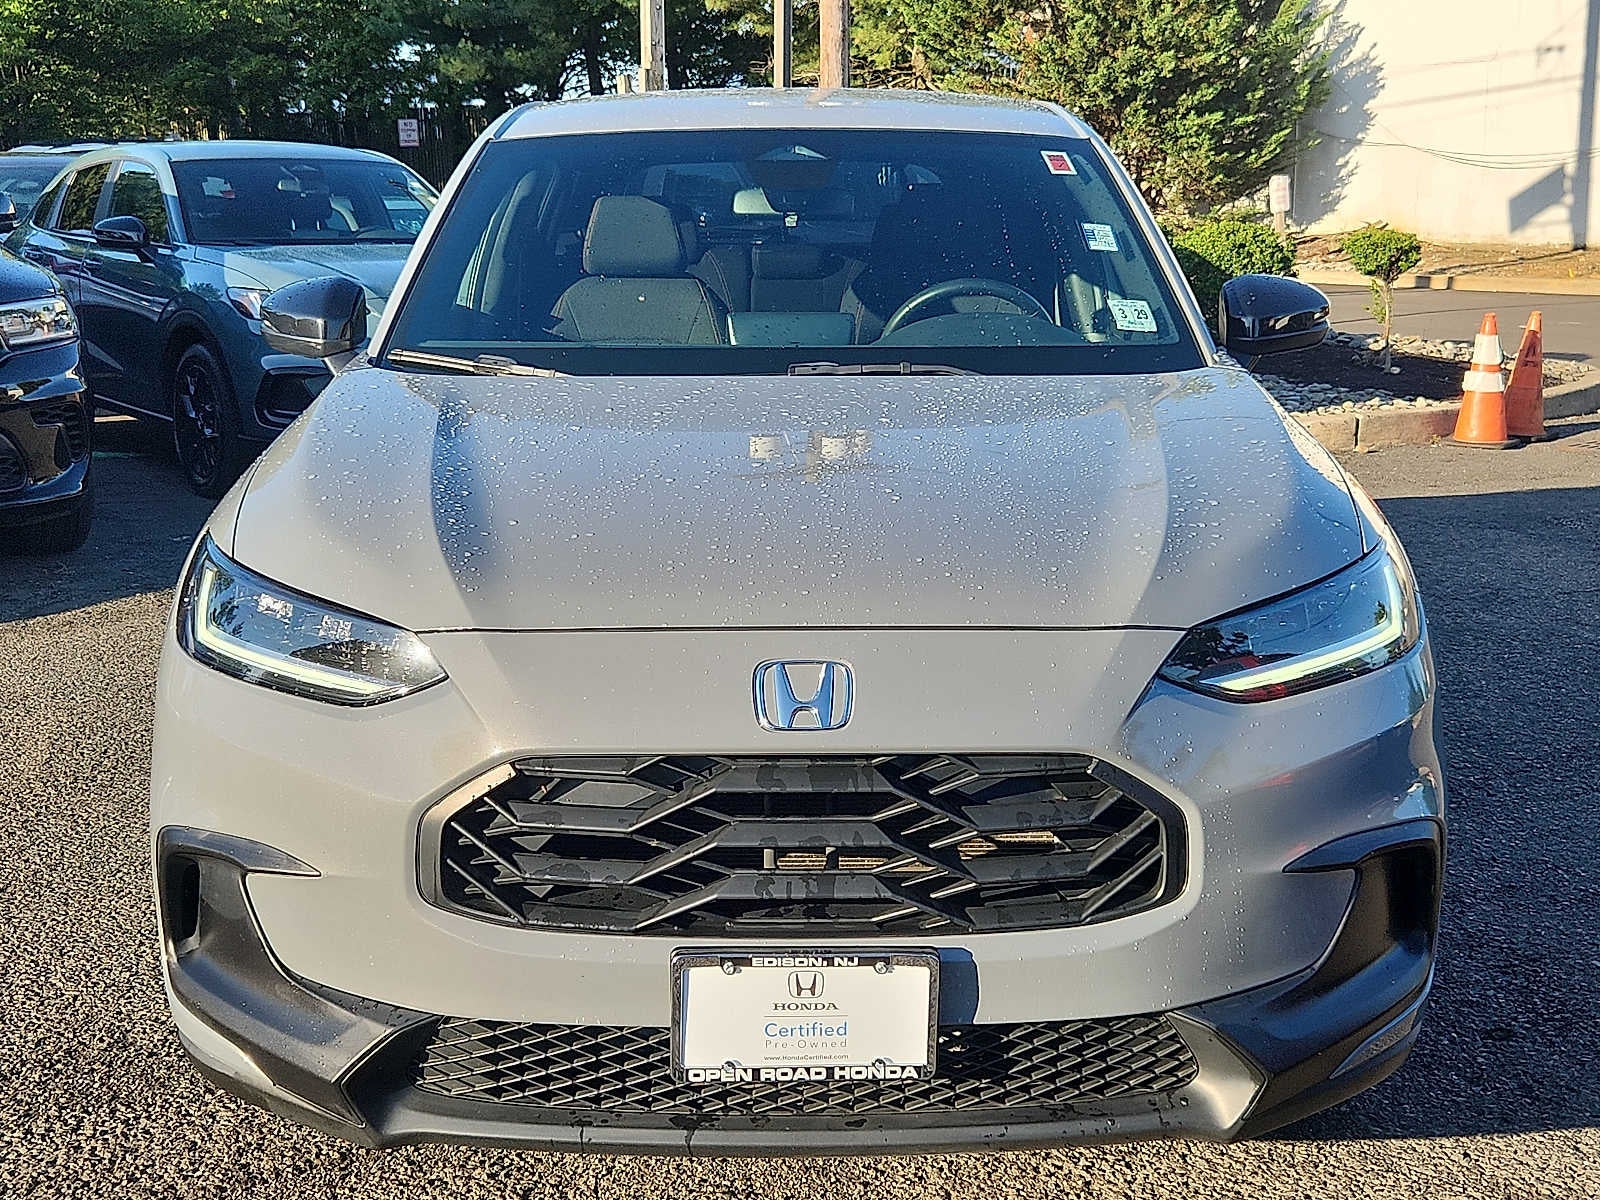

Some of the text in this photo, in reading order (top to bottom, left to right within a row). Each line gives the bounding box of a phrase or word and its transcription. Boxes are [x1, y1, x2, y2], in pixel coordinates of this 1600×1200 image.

[1118, 308, 1149, 320] 3 29
[751, 956, 859, 967] EDISON, NJ
[772, 1002, 839, 1011] HONDA
[764, 1021, 848, 1038] Certified
[765, 1039, 847, 1049] Pre-Owned
[687, 1065, 919, 1083] OPEN ROAD HONDA
